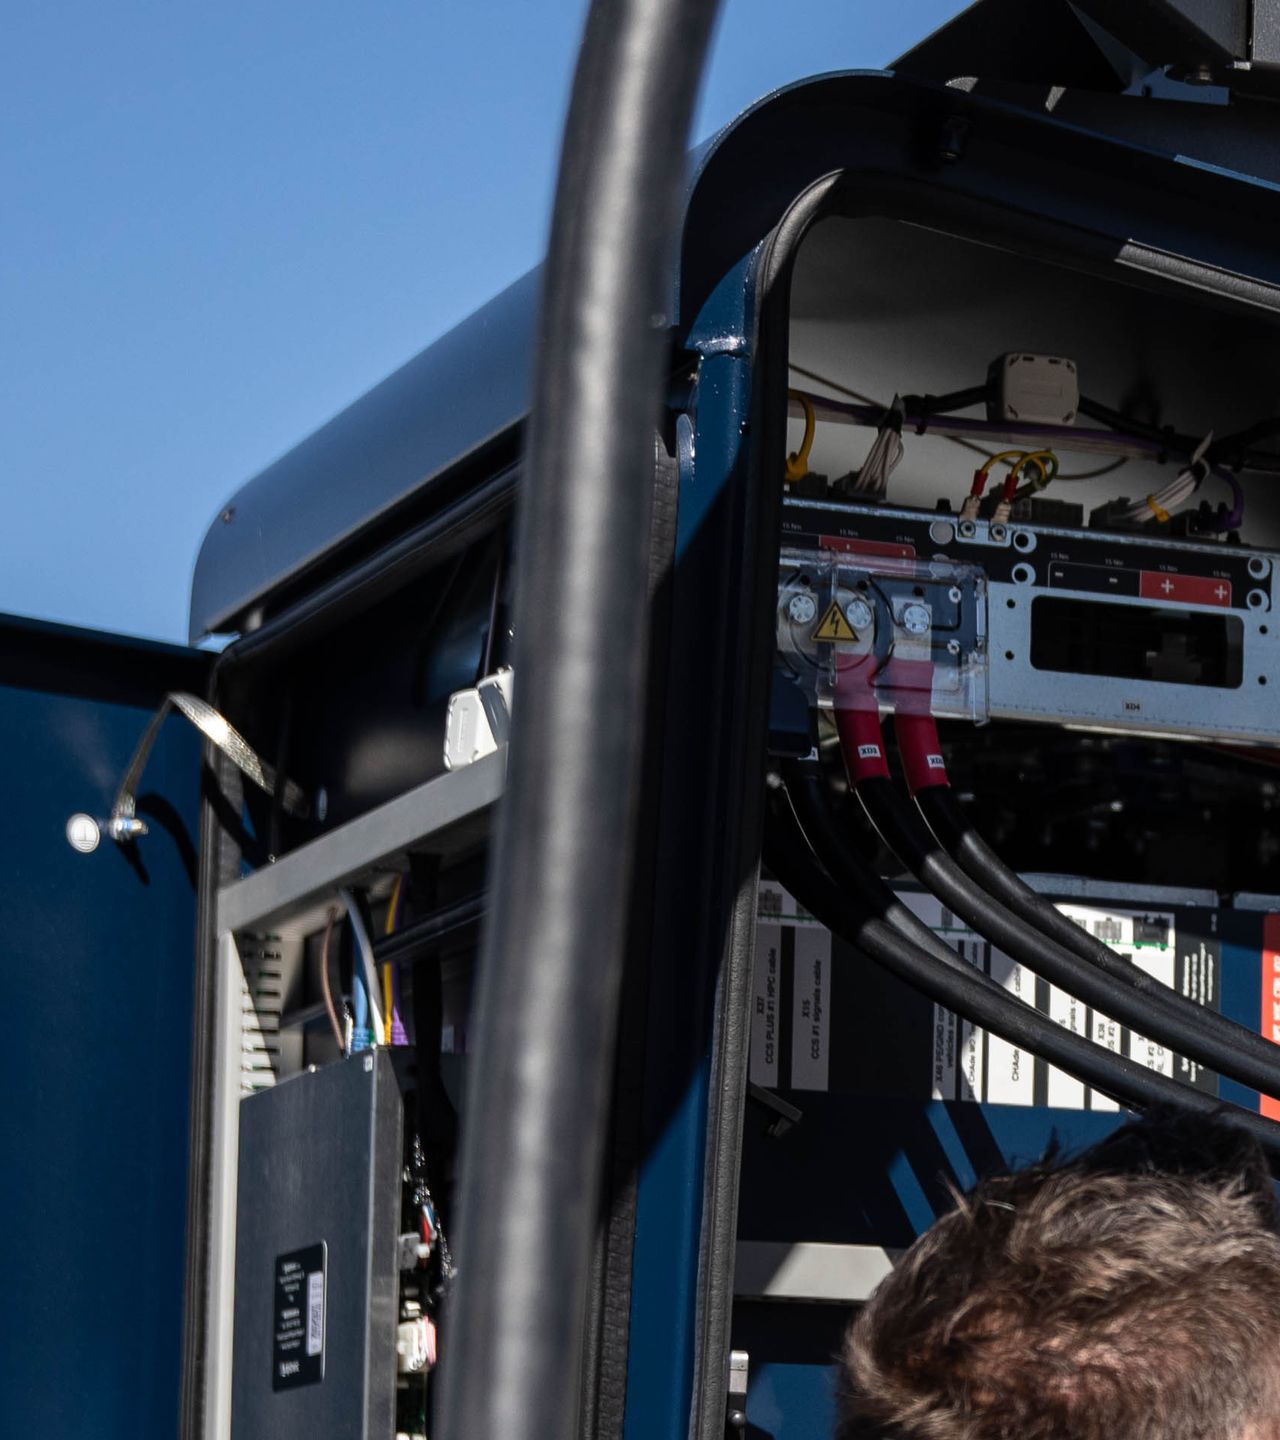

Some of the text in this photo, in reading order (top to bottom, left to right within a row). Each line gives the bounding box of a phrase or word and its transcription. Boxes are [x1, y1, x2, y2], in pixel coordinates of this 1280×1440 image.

[768, 948, 776, 974] cable
[767, 1000, 775, 1012] #1
[811, 959, 821, 1059] CCS #1 signals cable
[766, 1014, 775, 1041] PLUS
[765, 1043, 774, 1064] CCS
[946, 1030, 954, 1068] vehicles
